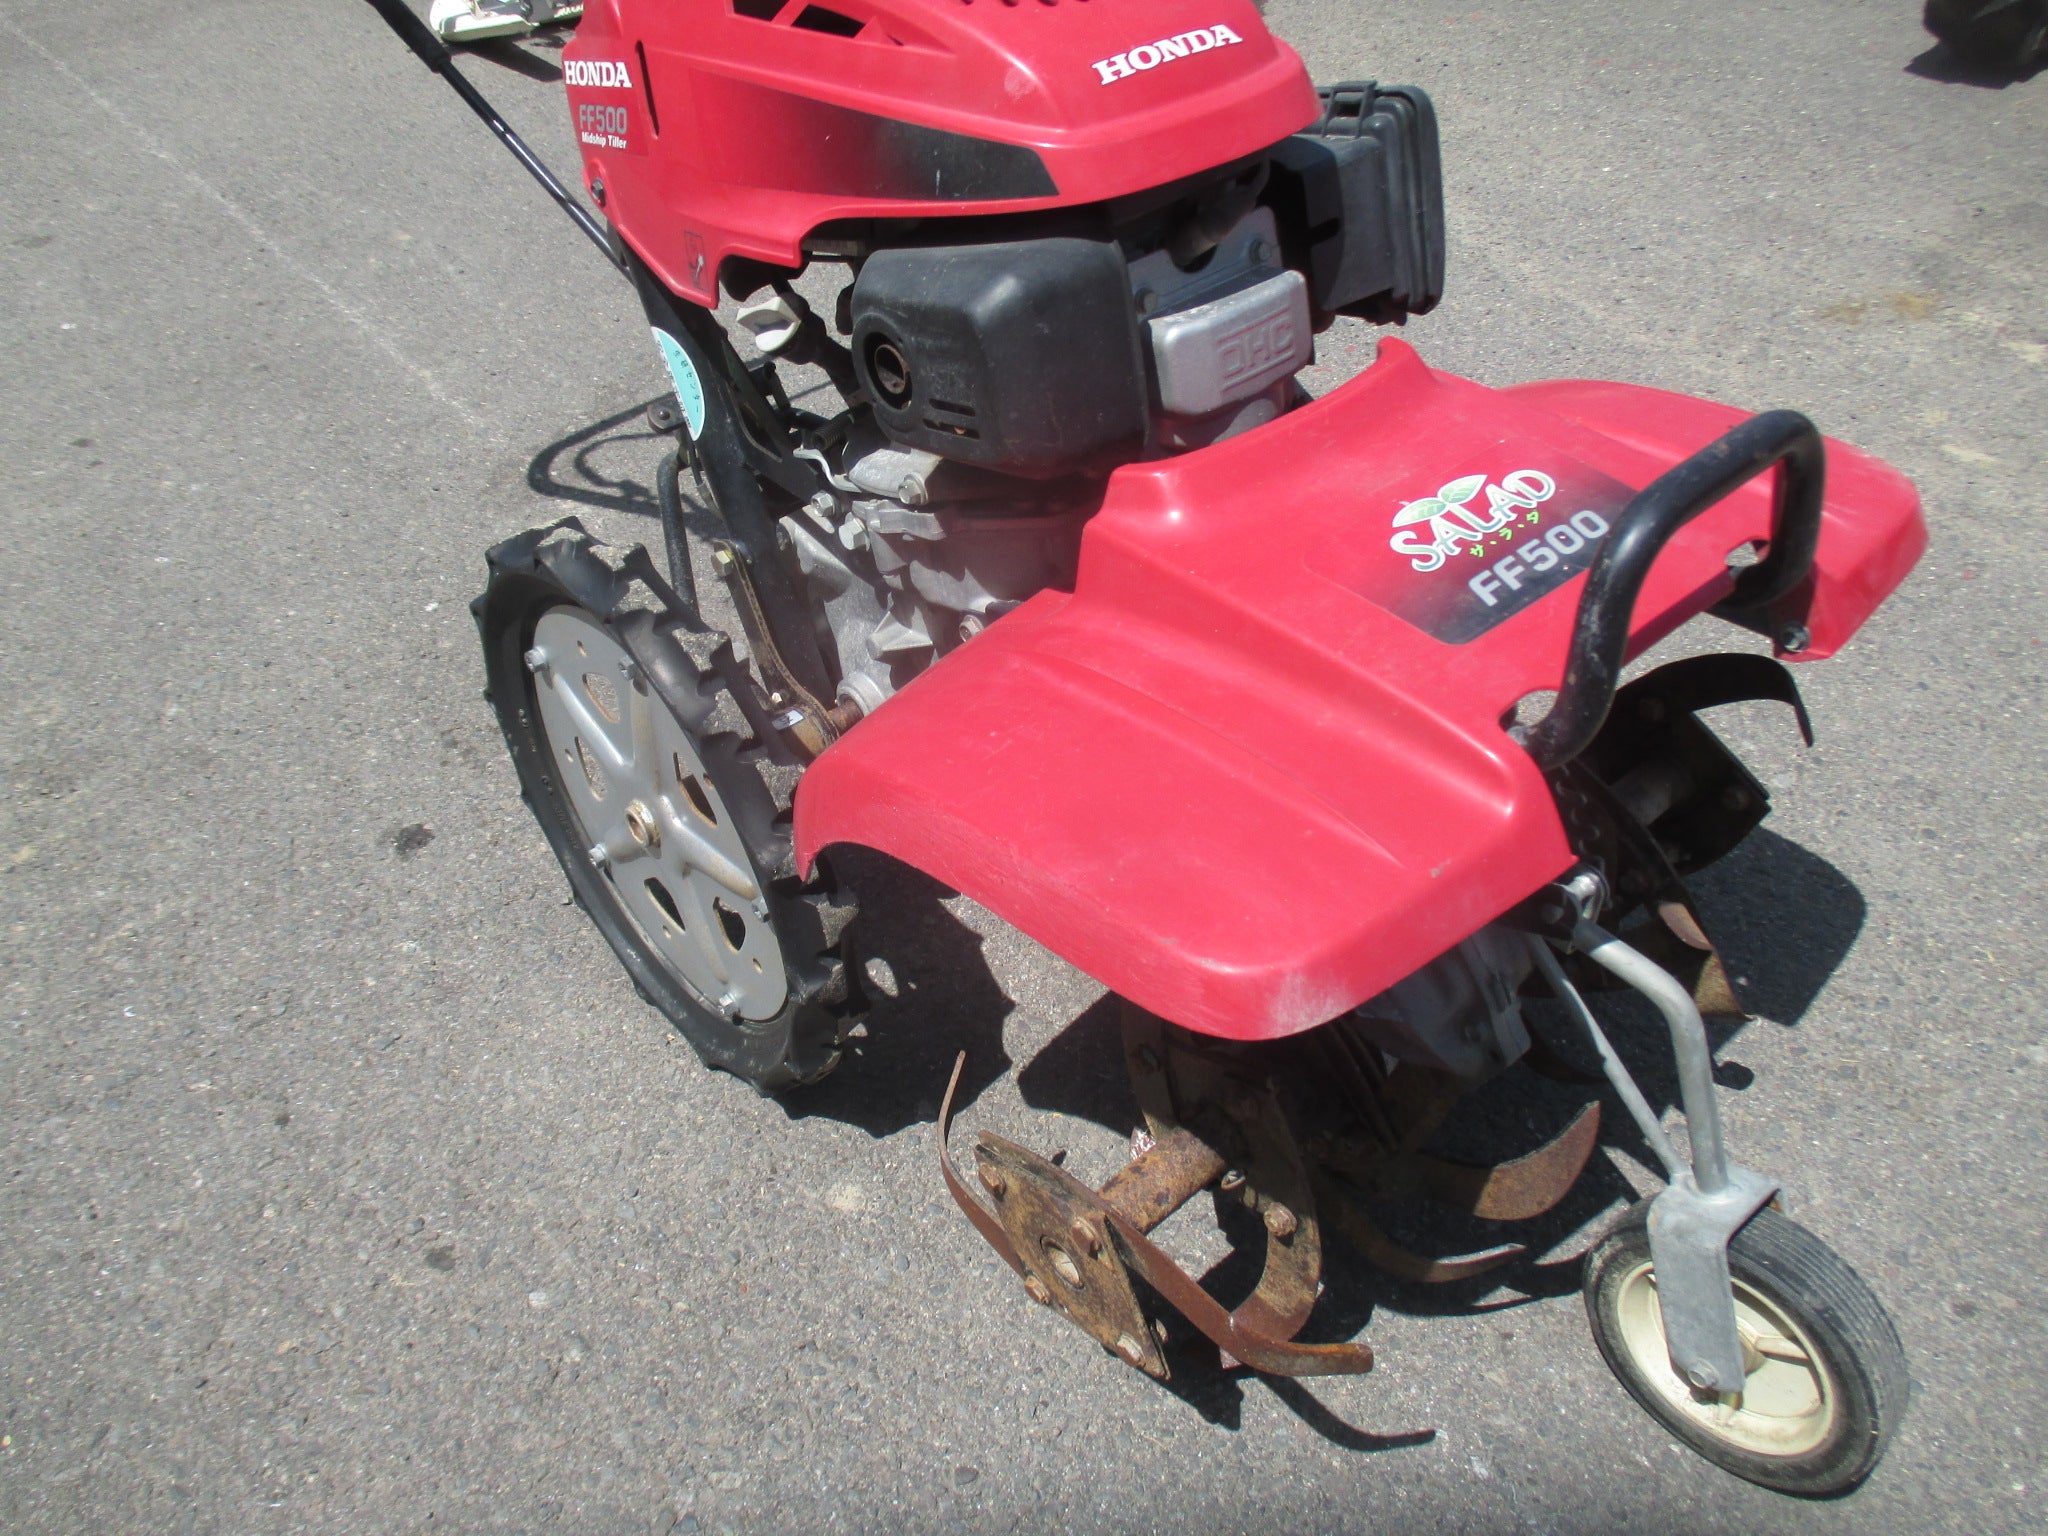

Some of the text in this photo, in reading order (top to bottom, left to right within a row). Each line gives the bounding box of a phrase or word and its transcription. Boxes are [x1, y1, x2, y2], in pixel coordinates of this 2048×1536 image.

[563, 60, 632, 88] HONDA
[1091, 24, 1243, 85] HONDA
[579, 104, 627, 134] FF500
[581, 131, 627, 149] Midship Tiller
[1390, 470, 1556, 572] SALAD
[1468, 510, 1609, 607] FF500
